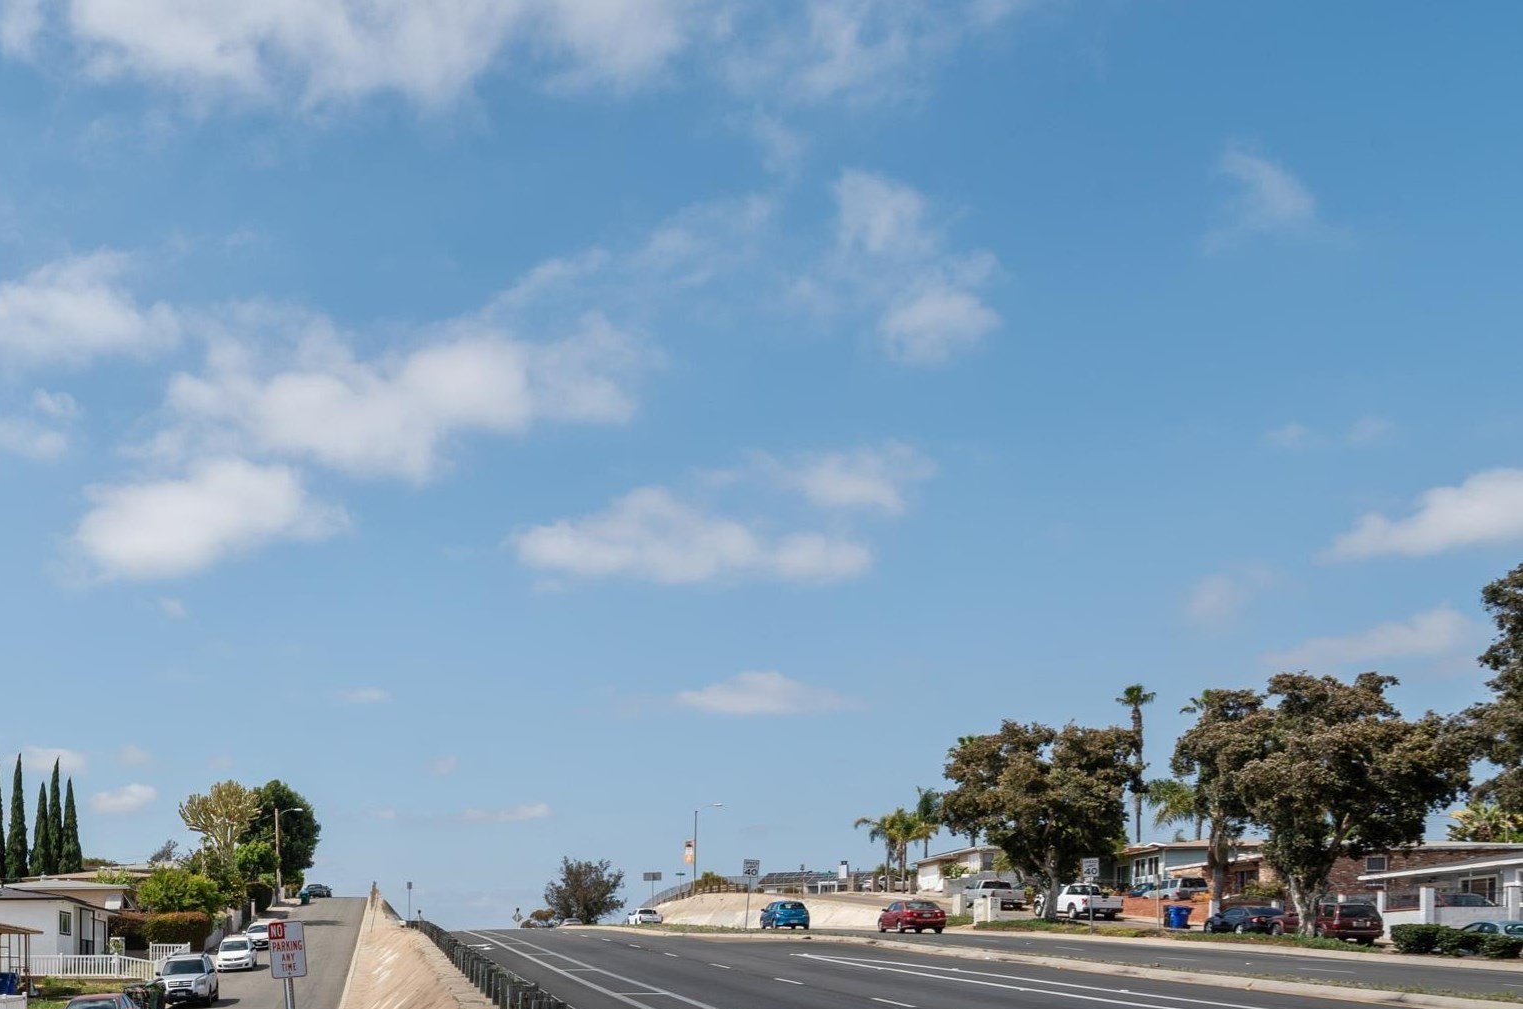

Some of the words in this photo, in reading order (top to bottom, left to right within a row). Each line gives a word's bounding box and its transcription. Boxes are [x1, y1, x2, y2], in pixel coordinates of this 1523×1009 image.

[270, 924, 283, 938] NO
[272, 940, 303, 952] PARKING
[281, 953, 295, 962] ANY
[281, 963, 297, 972] TIME
